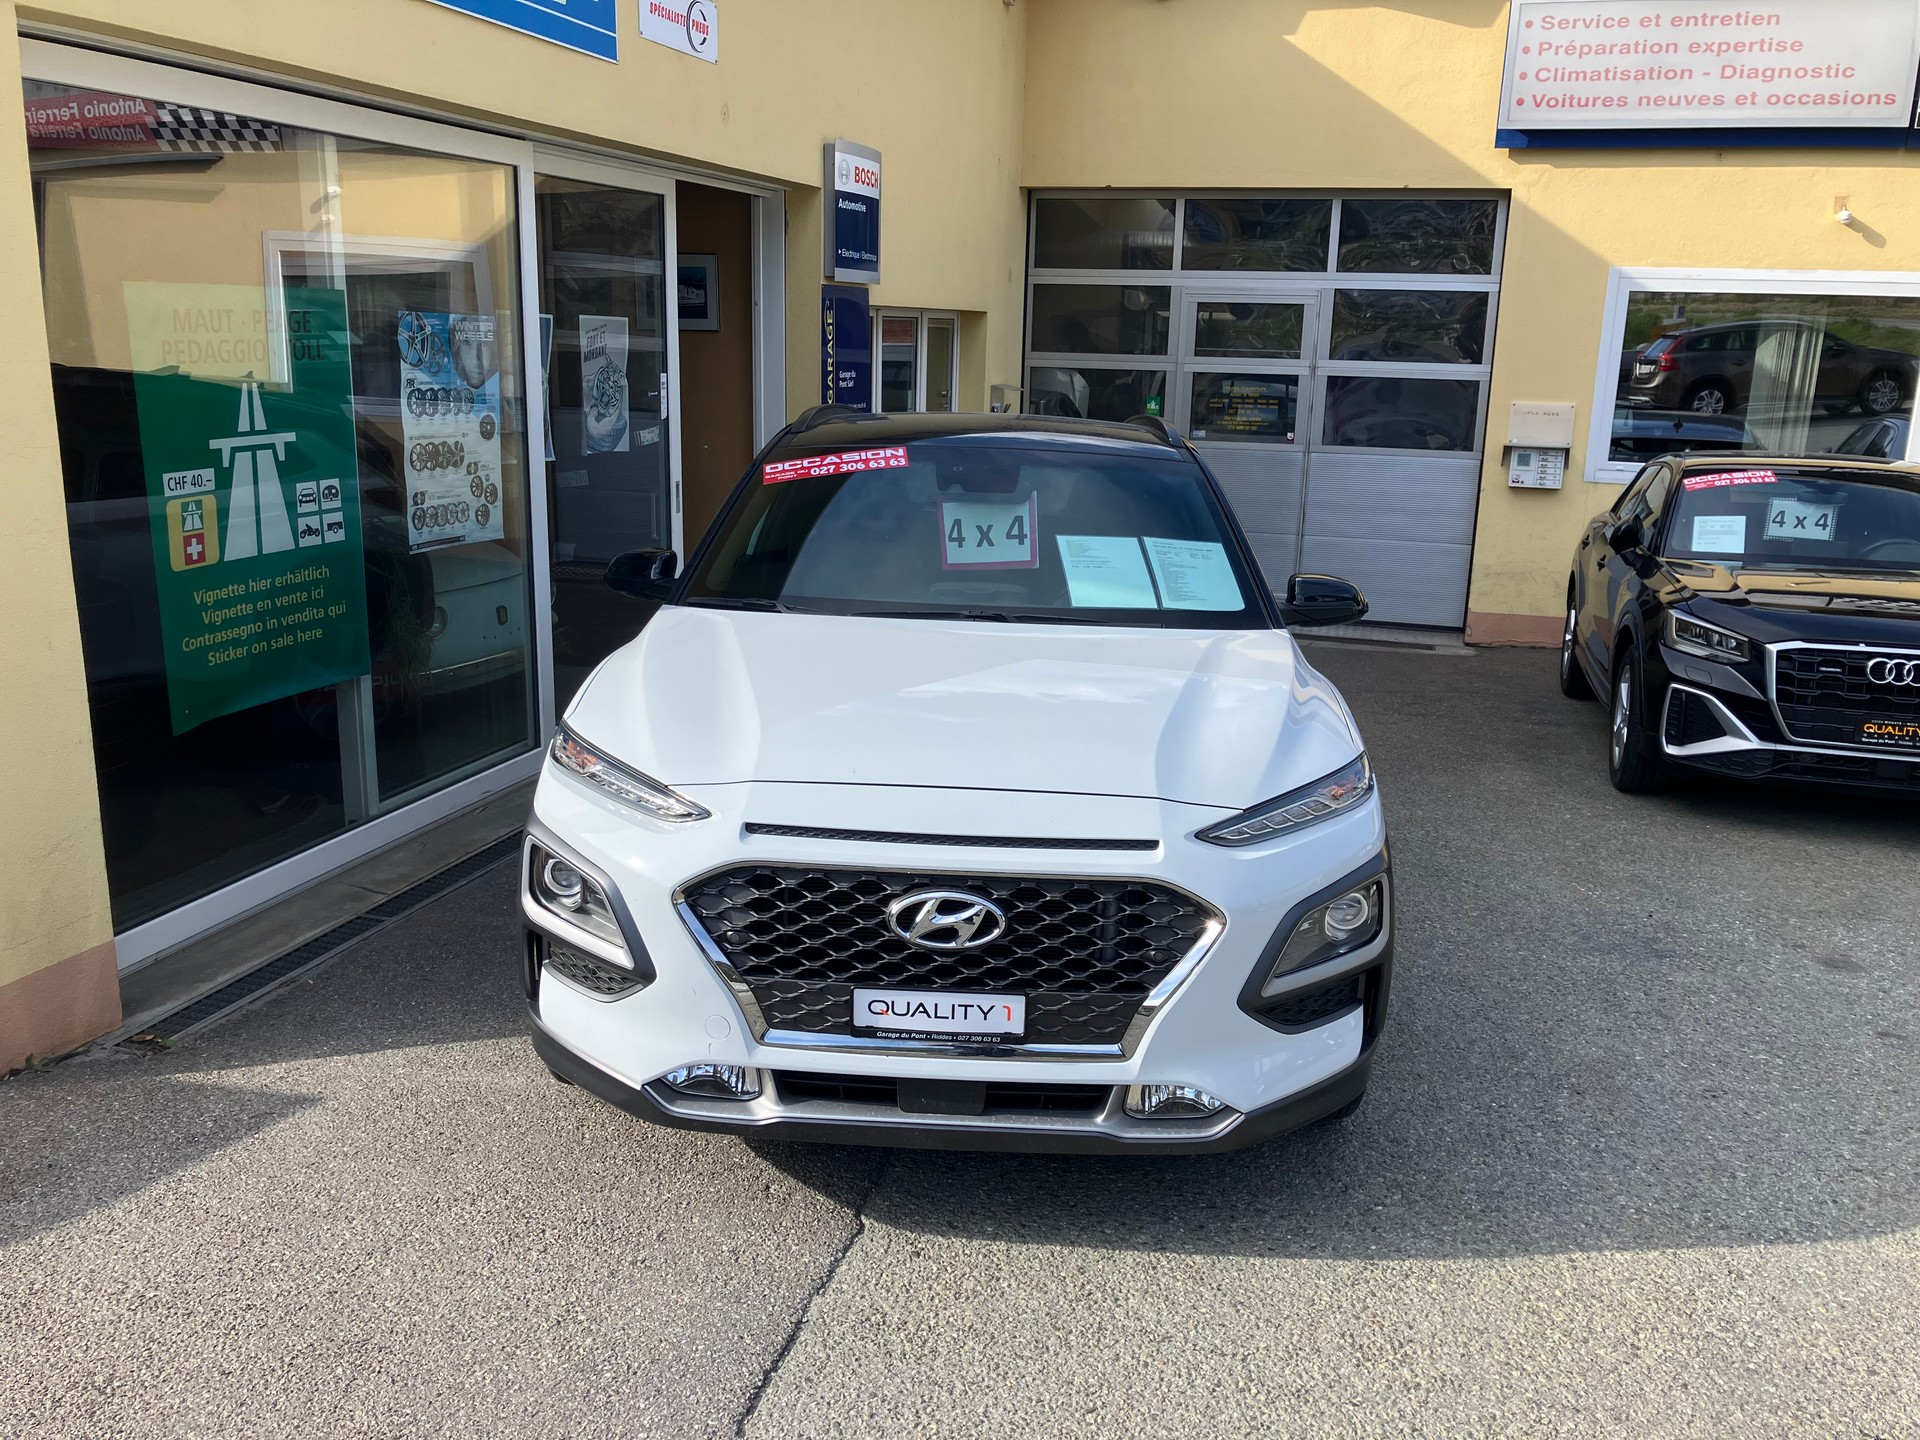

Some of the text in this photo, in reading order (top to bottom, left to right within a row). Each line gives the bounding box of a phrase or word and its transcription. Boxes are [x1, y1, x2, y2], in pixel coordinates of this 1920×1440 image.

[650, 2, 709, 36] SPÉCIALISTE PNEUS
[1540, 11, 1781, 31] Service et entretien
[1537, 38, 1804, 59] Préparation expertise
[1535, 66, 1694, 83] Climatisation
[1720, 64, 1856, 84] Diagnostic
[1532, 90, 1897, 109] Voitures neuves et occasions
[855, 166, 878, 189] BOSCH
[838, 198, 866, 212] Automotive
[172, 308, 234, 334] MAUT
[454, 321, 494, 331] WINTER
[455, 332, 494, 341] WHEELS
[162, 339, 325, 364] PEDAGGIO OLL
[824, 302, 834, 404] GARAGE
[765, 449, 903, 473] OCCASION
[810, 458, 906, 476] 027 306 63 63
[167, 475, 187, 491] CHF
[1684, 471, 1772, 484] OCCASION
[1772, 510, 1829, 530] 4 x 4
[948, 515, 1027, 548] 4 x 4
[194, 565, 330, 606] Vignette hier erhältlich
[202, 586, 324, 625] Vignette en vente ici
[182, 601, 346, 651] Contrassegno in vendita qui
[208, 627, 323, 666] Sticker on sale here
[868, 1000, 996, 1021] QUALITY
